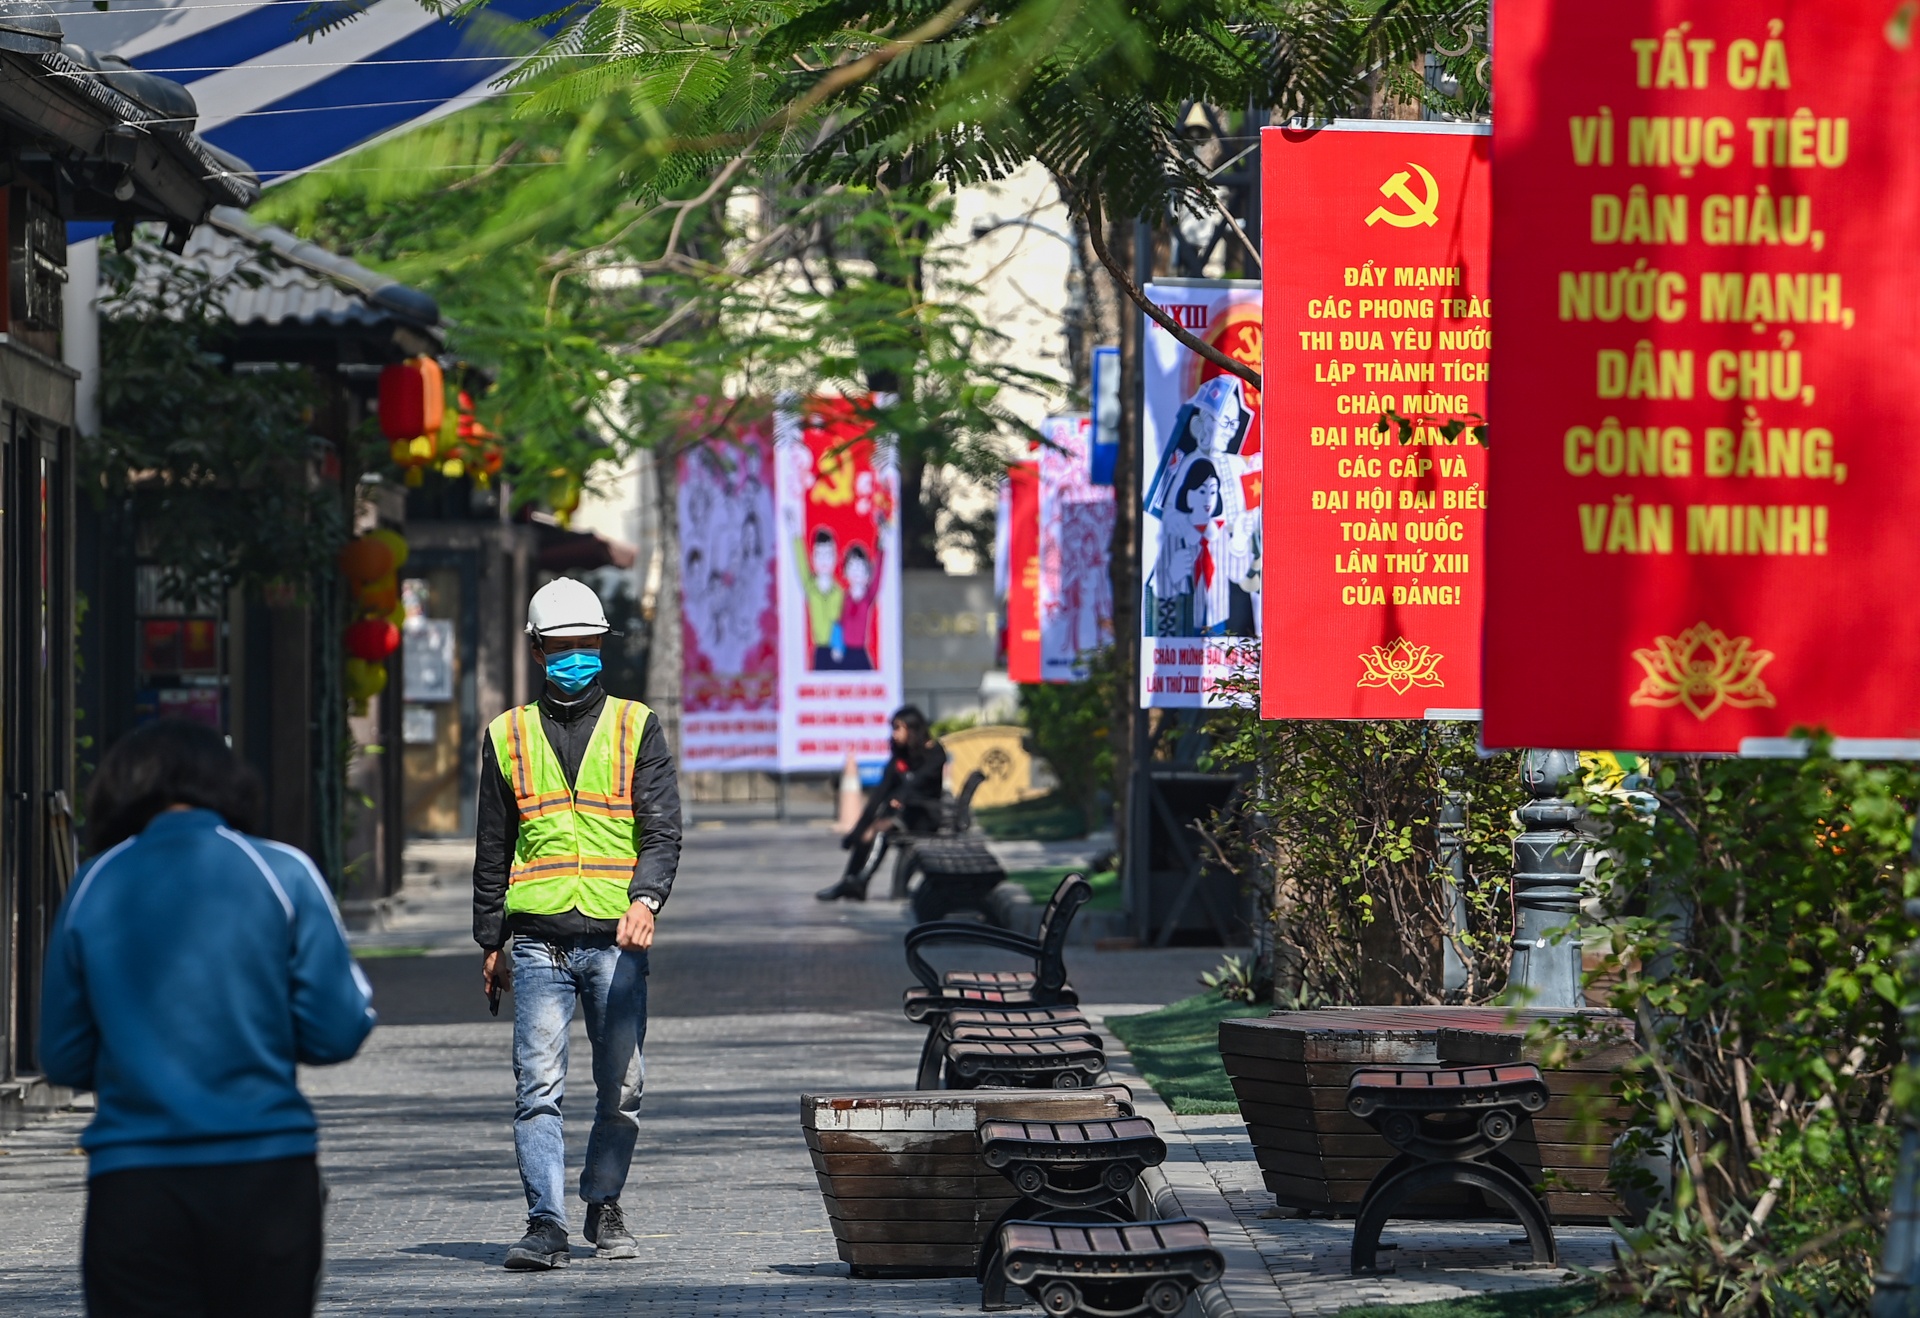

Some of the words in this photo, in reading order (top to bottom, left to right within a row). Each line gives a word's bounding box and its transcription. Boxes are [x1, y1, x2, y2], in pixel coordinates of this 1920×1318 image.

[1631, 21, 1716, 89] TẤT
[1727, 19, 1790, 90] CẢ
[1570, 106, 1614, 166] VÌ
[1628, 116, 1735, 178] MỤC
[1747, 107, 1849, 168] TIÊU
[1591, 184, 1688, 244] DÂN
[1701, 185, 1825, 252] GIÀU,
[1344, 260, 1387, 287] ĐẨY
[1394, 267, 1460, 291] MẠNH
[1308, 295, 1352, 319] CÁC
[1358, 298, 1434, 319] PHONG
[1559, 258, 1687, 322] NƯỚC
[1700, 273, 1855, 334] MẠNH,
[1169, 304, 1208, 328] XIII
[1299, 331, 1332, 350] THI
[1339, 331, 1384, 350] ĐUA
[1391, 327, 1432, 350] YÊU
[1315, 359, 1356, 387] LẬP
[1363, 358, 1435, 382] THÀNH
[1441, 358, 1490, 382] TÍCH
[1597, 339, 1694, 399] DÂN
[1707, 330, 1815, 406] CHỦ,
[1337, 391, 1395, 415] CHÀO
[1403, 390, 1468, 415] MỪNG
[1311, 426, 1347, 450] ĐẠI
[1354, 423, 1391, 450] HỘI
[1563, 416, 1692, 477] CÔNG
[1705, 404, 1847, 484] BẰNG,
[1338, 454, 1381, 478] CÁC
[1389, 452, 1432, 478] CẤP
[1439, 454, 1467, 478] VÀ
[1312, 490, 1348, 514] ĐẠI
[1355, 486, 1392, 514] HỘI
[1398, 490, 1436, 514] ĐẠI
[1443, 482, 1488, 510] BIỂU
[1340, 518, 1398, 542] TOÀN
[1404, 515, 1463, 544] QUỐC
[1578, 494, 1673, 554] VĂN
[1687, 505, 1828, 555] MINH!
[1335, 547, 1377, 573] LẦN
[1384, 548, 1428, 573] THỨ
[1432, 553, 1469, 573] XIII
[1342, 577, 1386, 605] CỦA
[1392, 577, 1461, 606] ĐẢNG!
[1153, 645, 1176, 665] CHÀO
